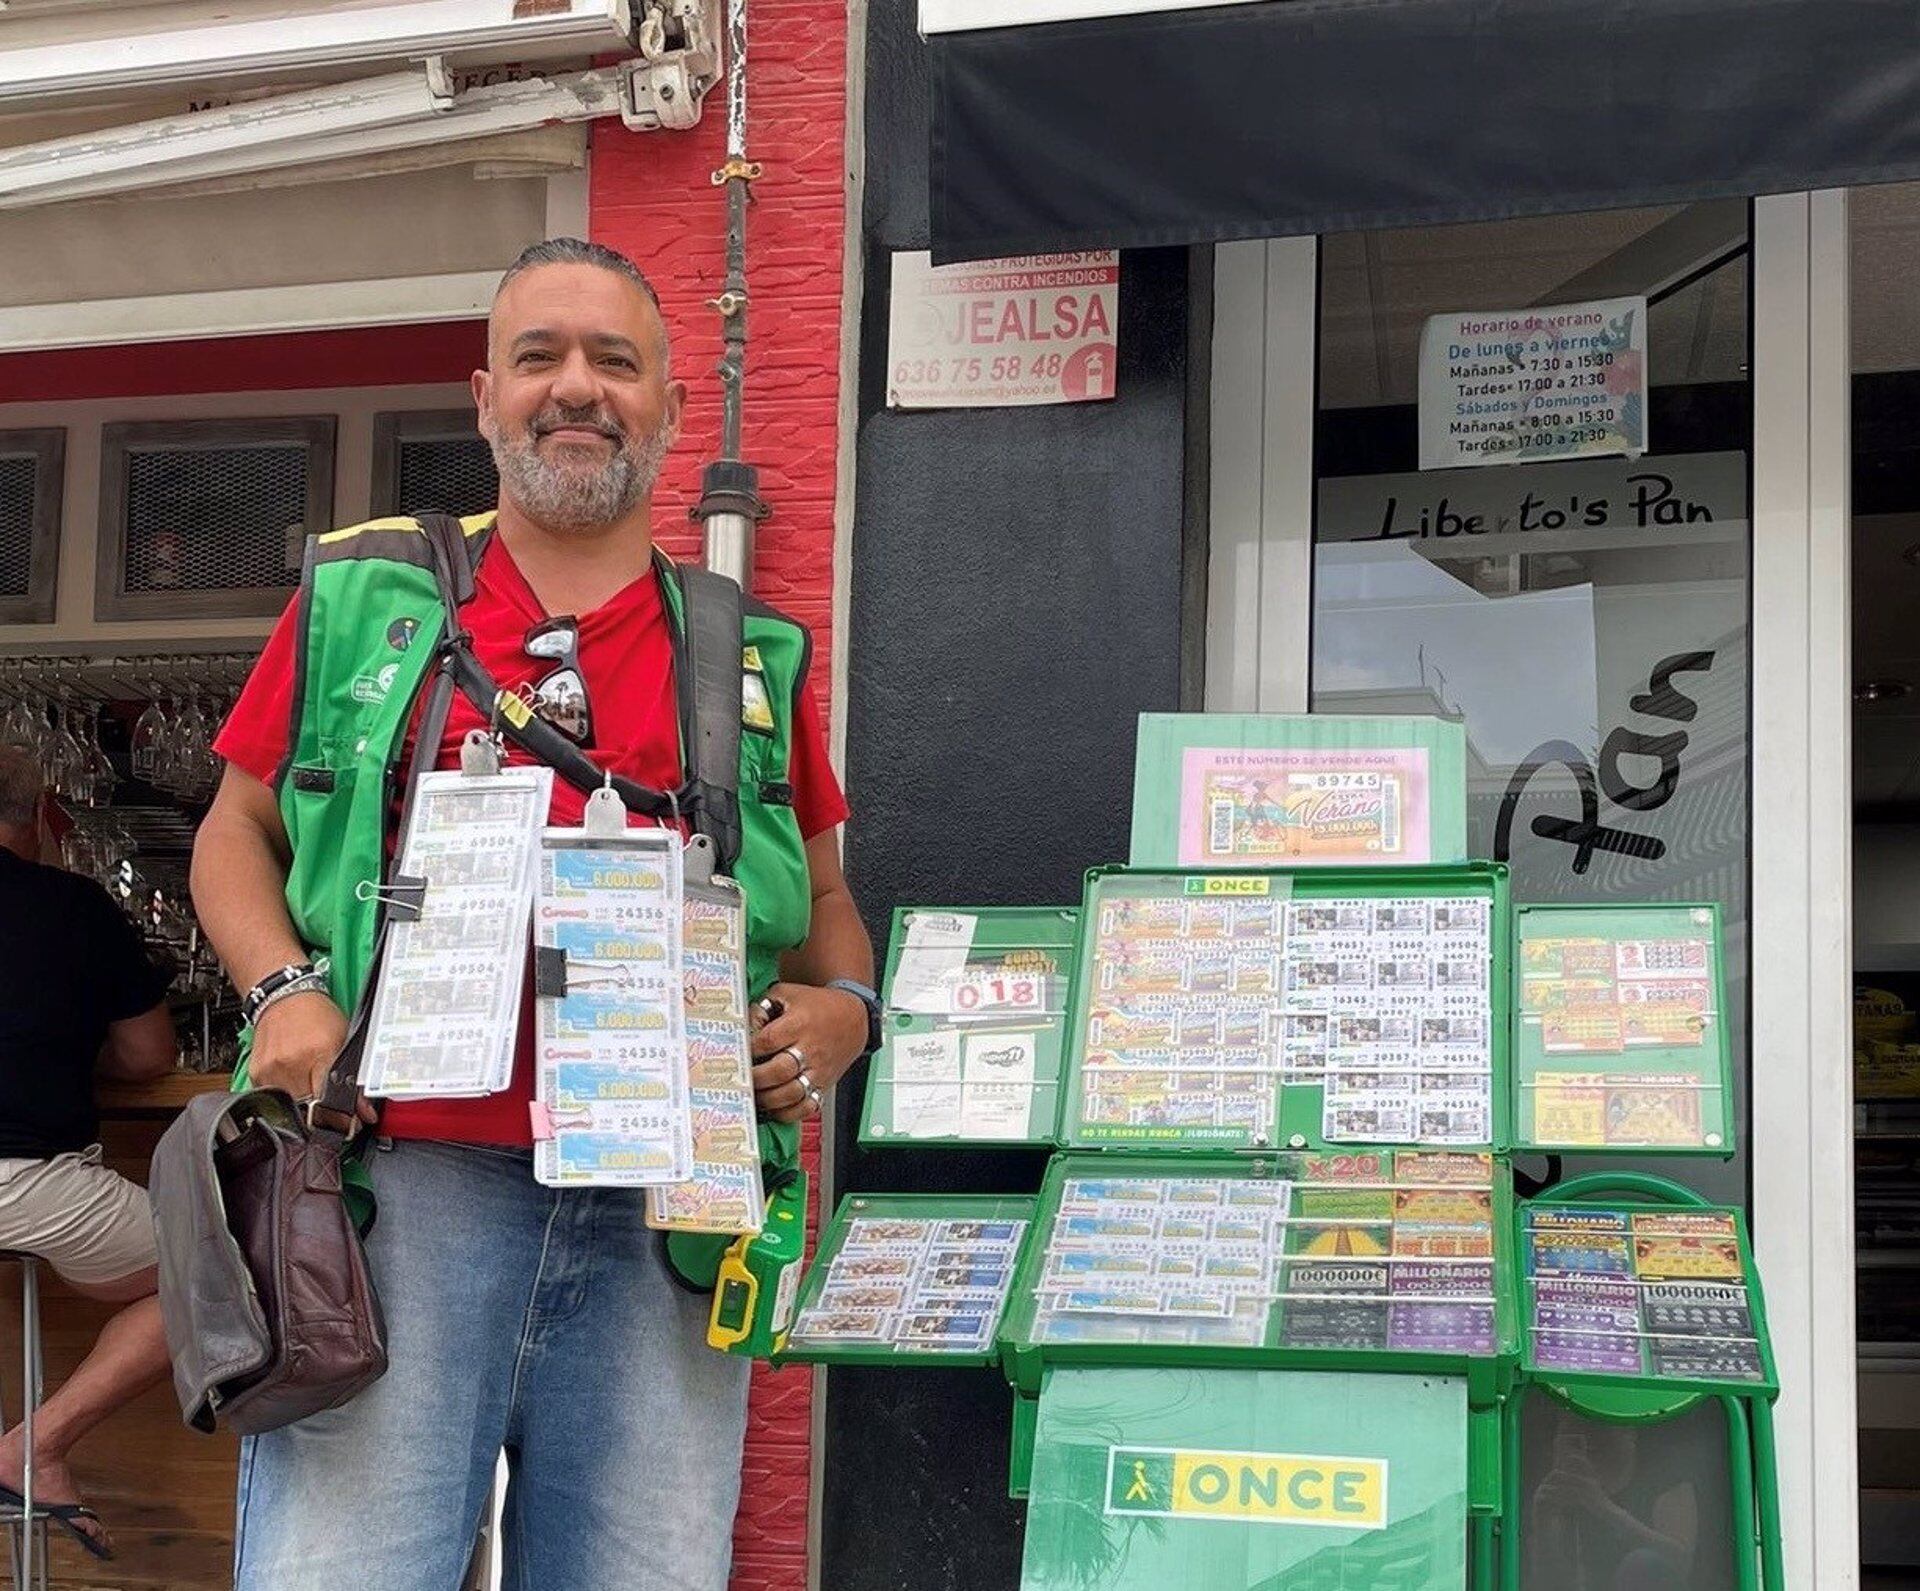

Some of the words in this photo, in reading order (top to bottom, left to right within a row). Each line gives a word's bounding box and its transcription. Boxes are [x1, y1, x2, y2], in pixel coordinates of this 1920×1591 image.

[972, 276, 1029, 292] CONTRA
[1033, 268, 1109, 286] INCENDIOS
[946, 294, 1111, 345] JEALSA
[1460, 318, 1519, 336] Horario
[1525, 315, 1541, 330] de
[1548, 313, 1604, 329] verano
[1449, 344, 1471, 360] De
[1477, 340, 1524, 357] lunes
[1529, 341, 1540, 351] a
[1546, 334, 1612, 351] viernes
[894, 359, 941, 384] 636
[950, 357, 982, 382] 75
[990, 355, 1021, 380] 58
[1029, 353, 1062, 379] 48
[1450, 363, 1515, 379] Mañanas
[1530, 357, 1560, 372] 7:30
[1564, 359, 1574, 369] a
[1577, 352, 1614, 368] 15:30
[1518, 376, 1553, 391] 17:00
[1557, 378, 1565, 388] a
[1570, 372, 1606, 387] 21:30
[1456, 400, 1517, 416] Sábados
[1522, 402, 1530, 413] y
[1534, 392, 1609, 410] Domingos
[1450, 418, 1515, 435] Mañanas
[1530, 412, 1561, 428] 8:00
[1564, 415, 1574, 425] a
[1578, 408, 1614, 423] 15:30
[1518, 433, 1553, 449] 17:00
[1557, 435, 1566, 445] a
[1570, 428, 1606, 443] 21:30
[1627, 473, 1714, 528] Pan
[1317, 774, 1378, 788] 89745
[1288, 790, 1383, 829] Verano
[1209, 880, 1265, 892] ONCE
[615, 907, 664, 920] 24356
[618, 1047, 667, 1059] 24356
[620, 1116, 670, 1129] 24356
[1393, 1267, 1491, 1279] MILLONARIO
[1538, 1281, 1635, 1297] MILLONARIO
[1189, 1464, 1367, 1513] ONCE
